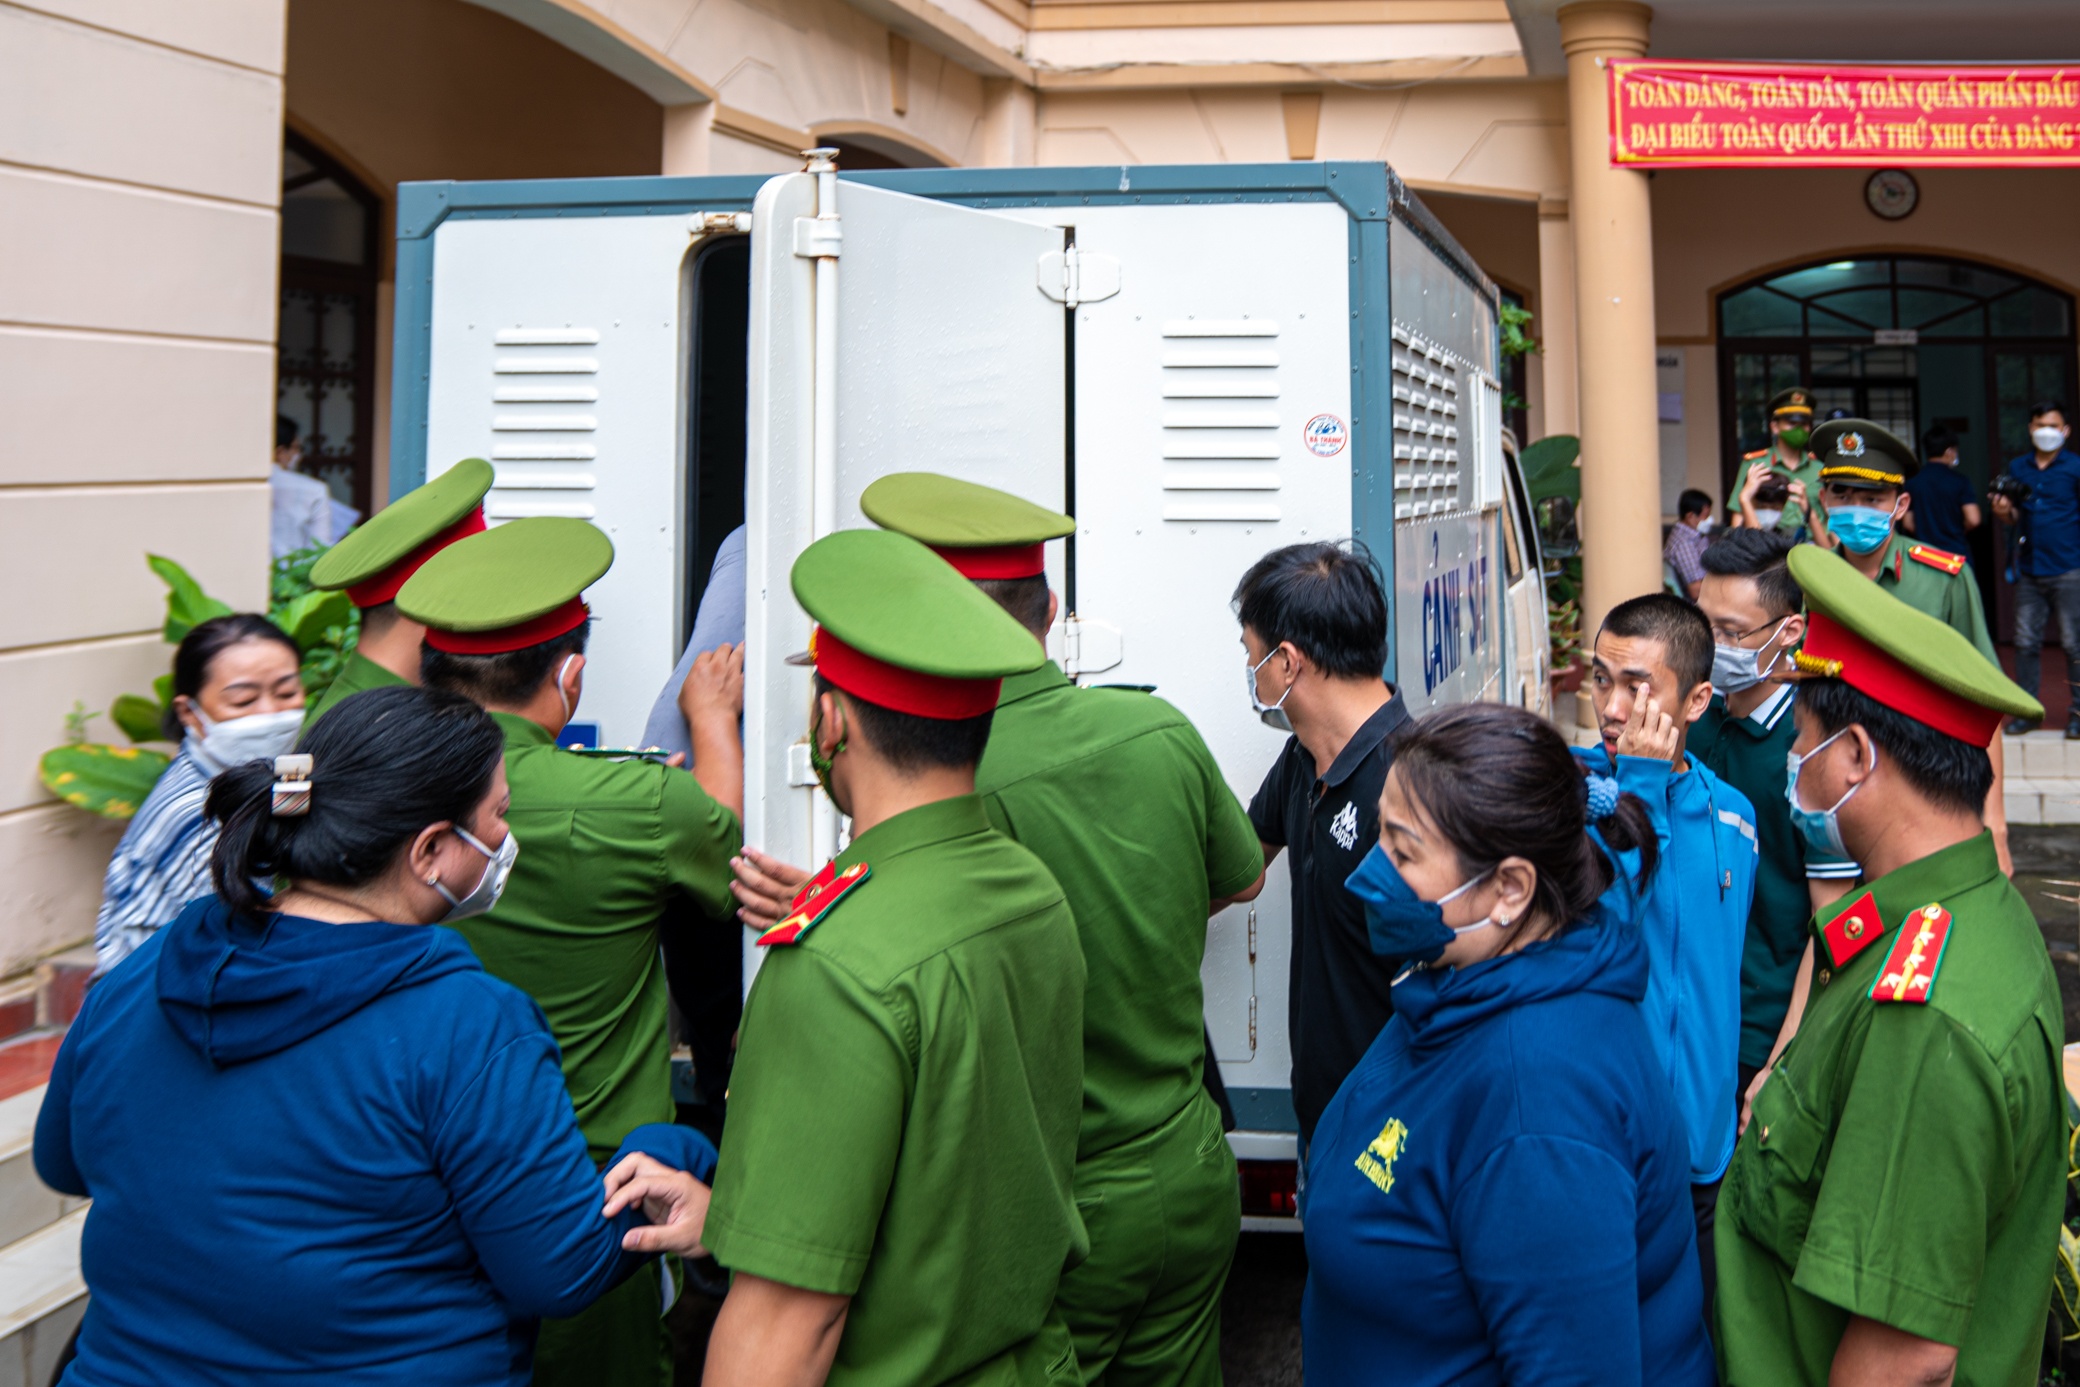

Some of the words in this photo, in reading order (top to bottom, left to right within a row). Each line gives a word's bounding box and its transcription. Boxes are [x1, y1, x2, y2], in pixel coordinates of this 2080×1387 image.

[1625, 75, 1682, 108] TOÀN
[1684, 73, 1747, 112] ĐẢNG,
[1748, 75, 1804, 108] TOÀN
[1857, 74, 1914, 108] TOÀN
[1916, 74, 1974, 114] QUÂN
[1977, 70, 2032, 108] PHẤN
[1630, 123, 1666, 155] ĐẠI
[1719, 116, 1776, 149] TOÀN
[1778, 111, 1836, 154] QUỐC
[1930, 123, 1967, 149] XIII
[1970, 115, 2013, 149] CỦA
[2015, 114, 2074, 149] ĐẢNG
[1422, 530, 1461, 697] CẢNH
[1468, 532, 1488, 656] SÁT
[1329, 819, 1354, 851] Kappa
